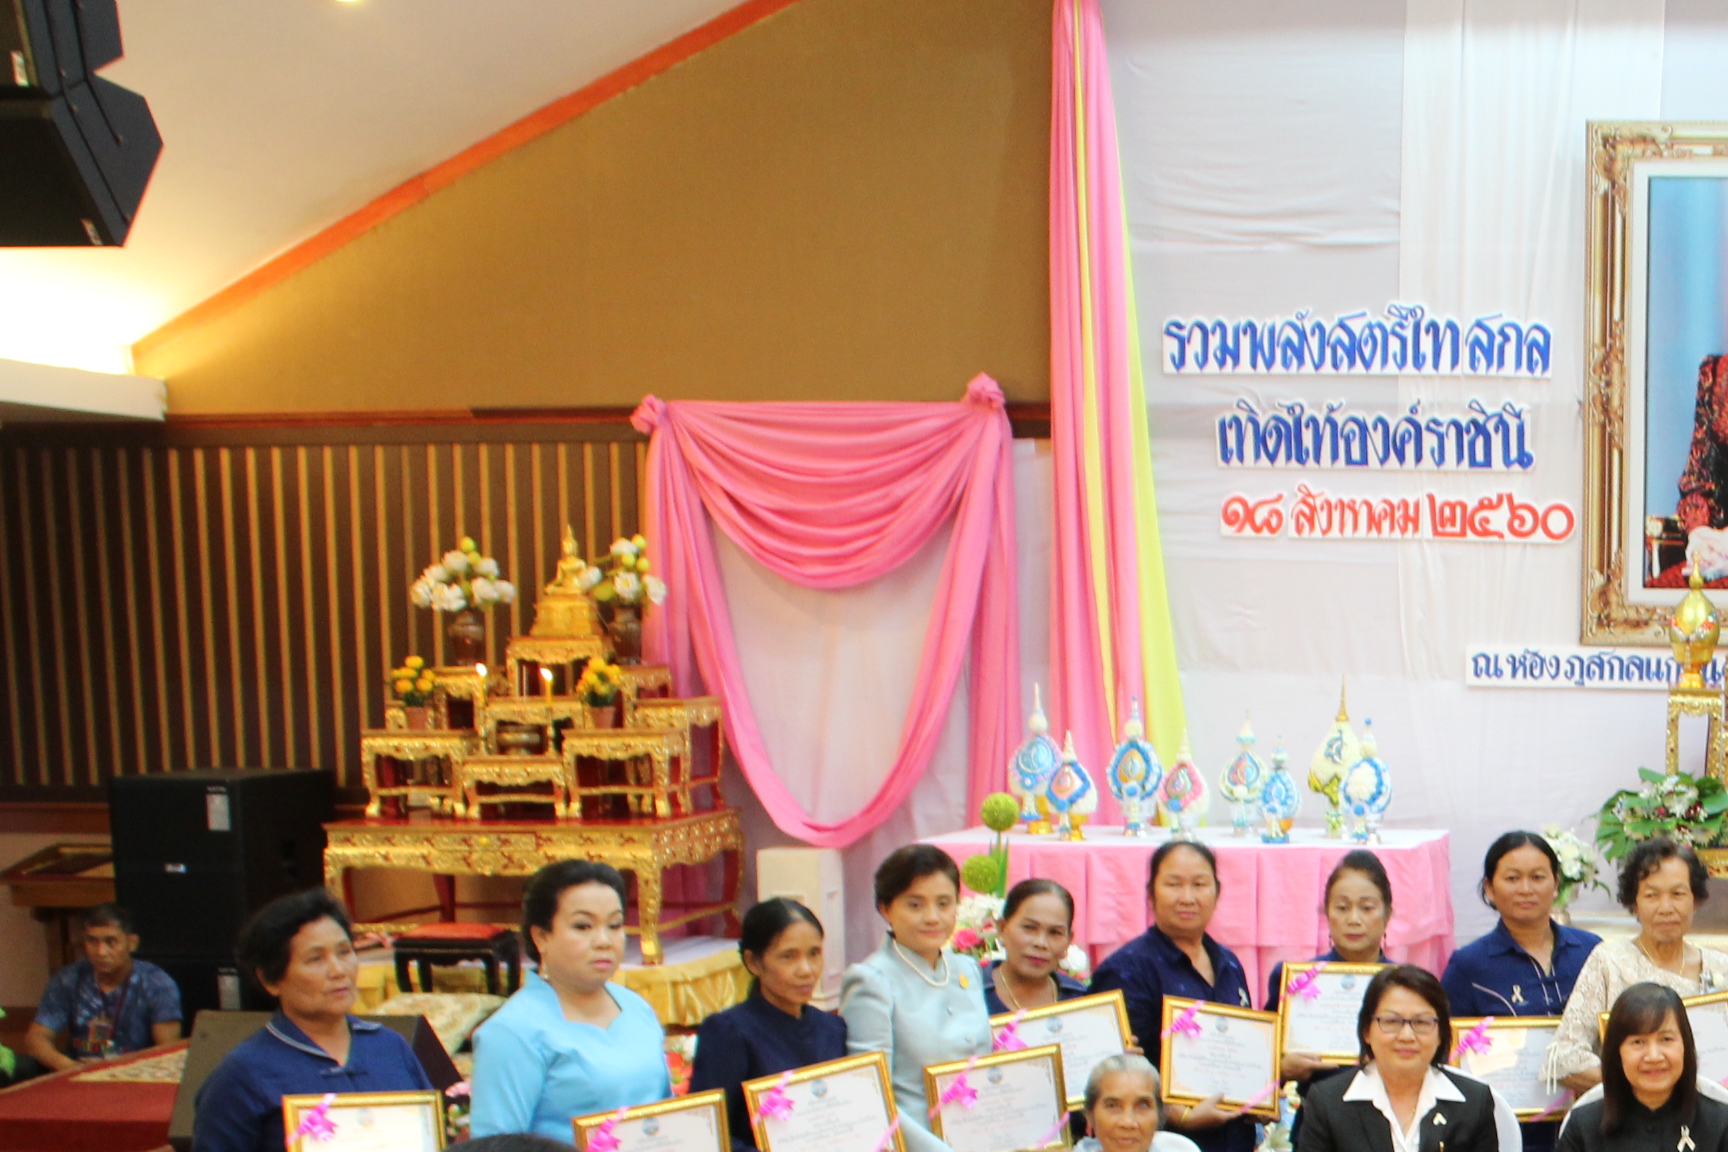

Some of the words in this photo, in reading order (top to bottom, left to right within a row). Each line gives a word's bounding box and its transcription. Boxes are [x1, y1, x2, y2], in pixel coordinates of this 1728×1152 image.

[1216, 398, 1535, 470] เทิดไท้องค์ราชินี
[1221, 492, 1284, 535] ๑๘
[1291, 483, 1421, 537] สิงหาคม
[1426, 493, 1576, 541] ๒๕๖๐
